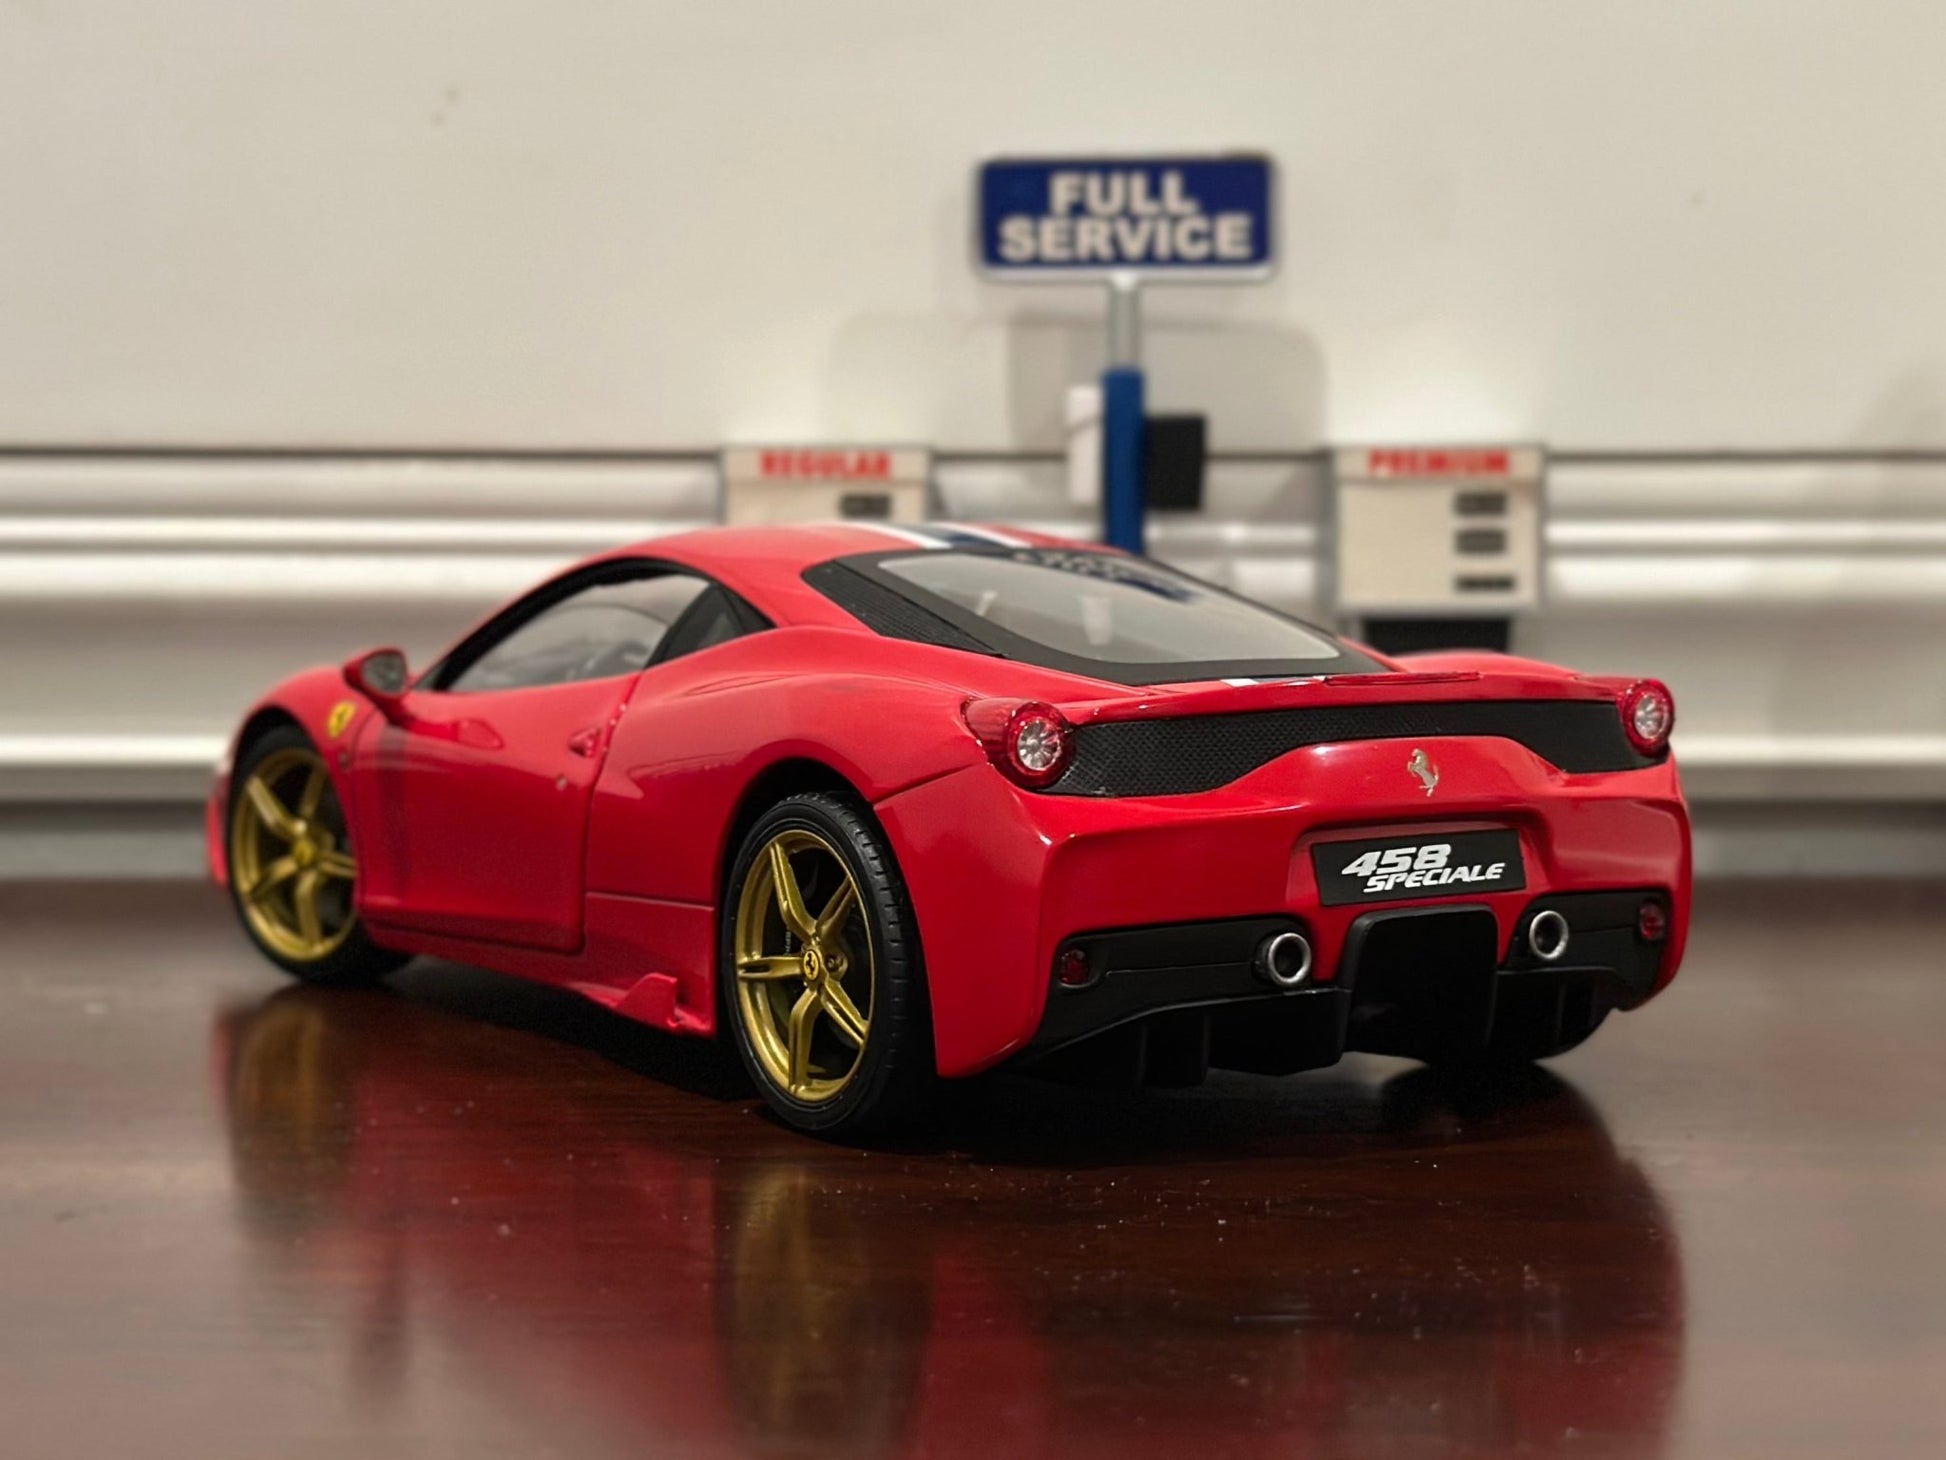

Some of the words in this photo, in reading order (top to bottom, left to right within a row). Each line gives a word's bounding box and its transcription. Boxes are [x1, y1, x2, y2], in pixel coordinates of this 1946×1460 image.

[1050, 171, 1199, 215] FULL
[1000, 215, 1253, 262] SERVICE
[761, 450, 892, 478] REGULAR
[1368, 449, 1510, 477] PREMIUM
[1341, 844, 1451, 876] 458
[1363, 863, 1505, 893] SPECIALE
